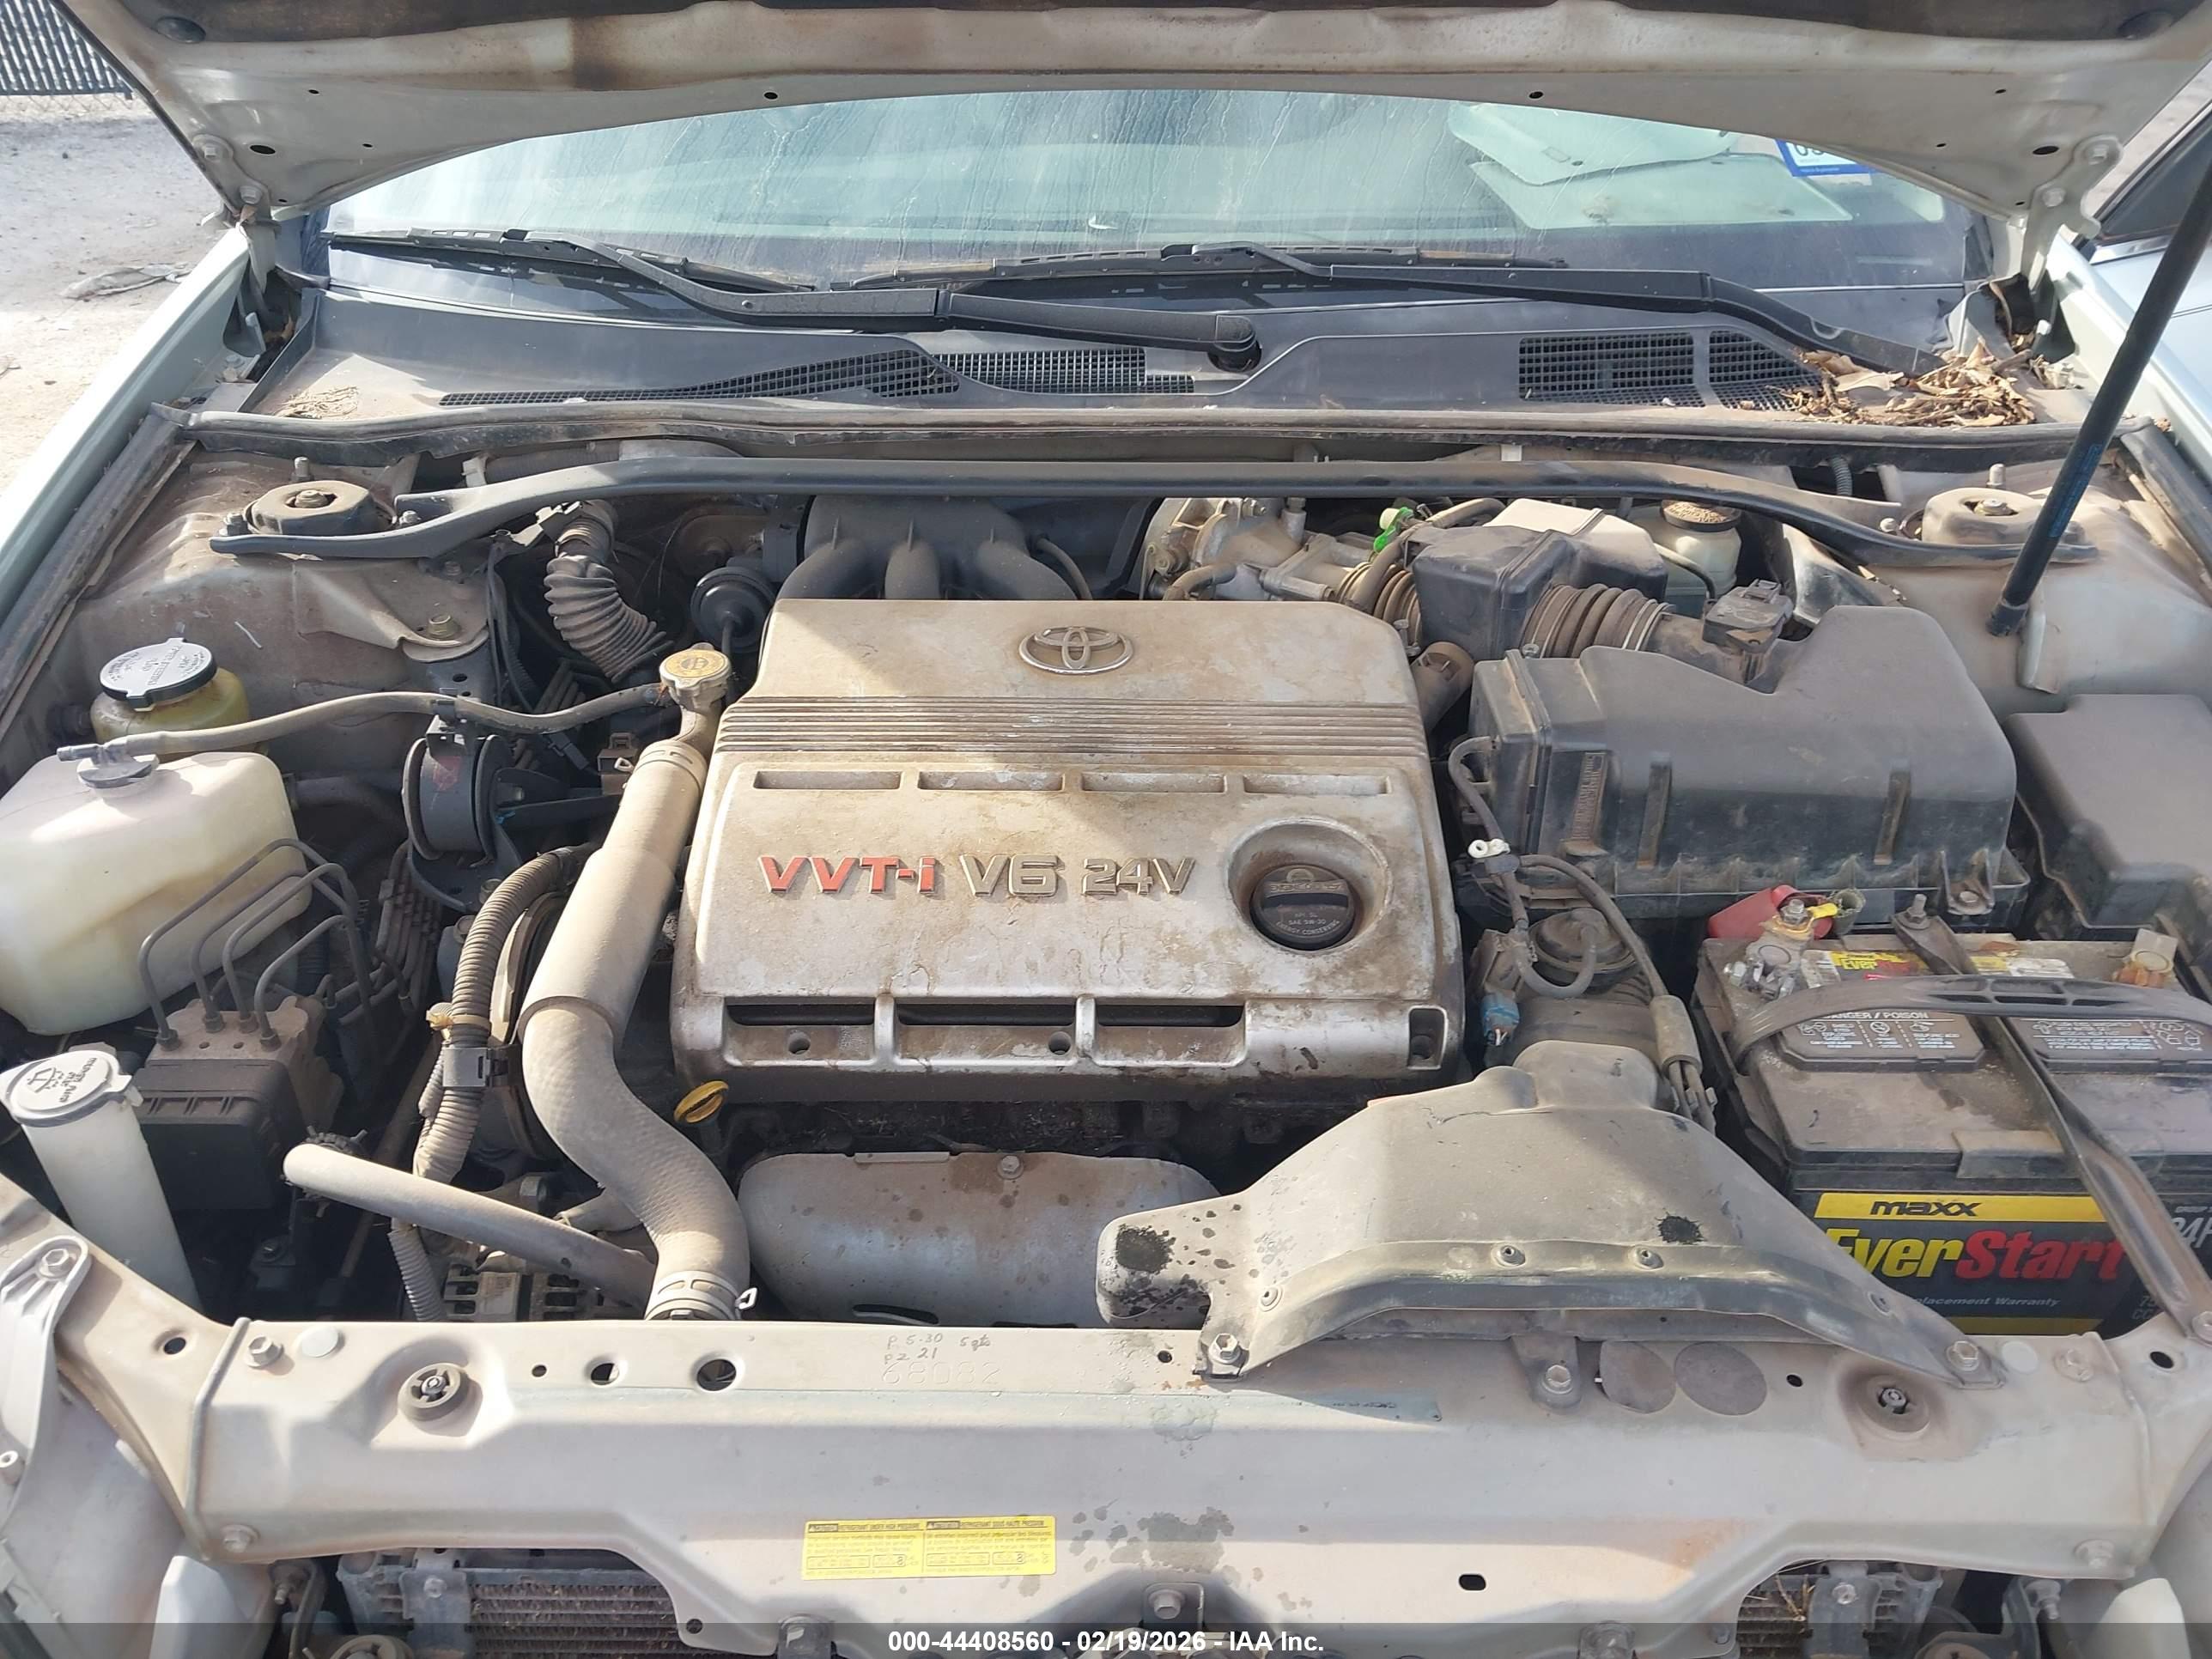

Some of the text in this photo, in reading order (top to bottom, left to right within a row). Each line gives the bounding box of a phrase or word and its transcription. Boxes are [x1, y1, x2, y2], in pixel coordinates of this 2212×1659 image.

[757, 854, 1197, 897] VVT-i V6 24V
[1869, 1200, 1981, 1217] maxx
[1995, 1297, 2061, 1307] Warranty
